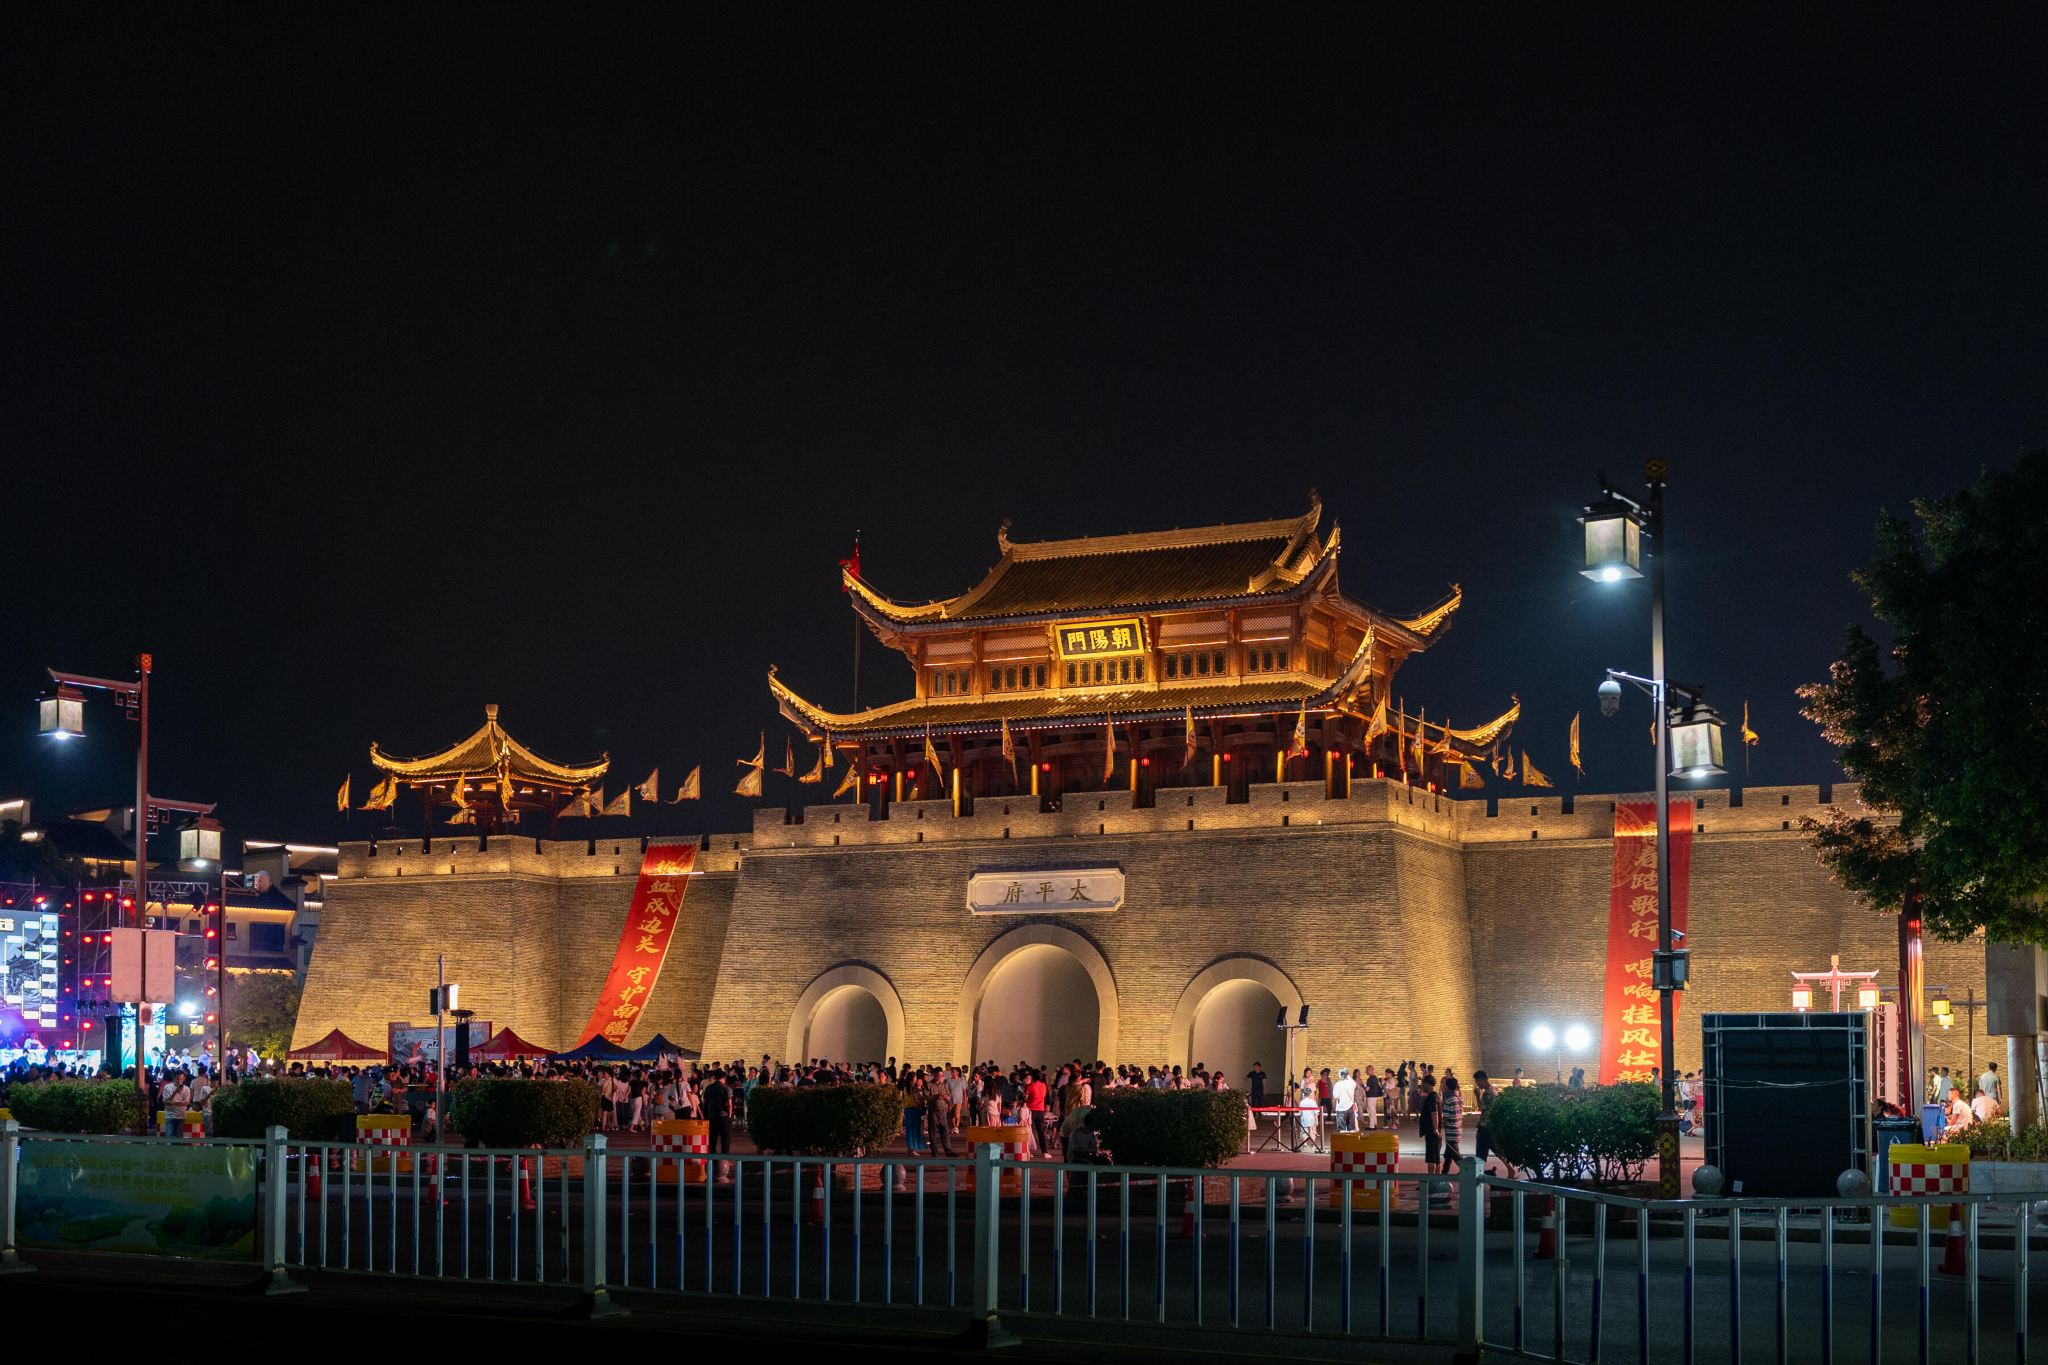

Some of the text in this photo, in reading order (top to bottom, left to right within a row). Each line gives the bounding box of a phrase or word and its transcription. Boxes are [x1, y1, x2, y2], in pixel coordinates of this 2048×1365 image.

[1067, 628, 1132, 651] 朝陽門
[1003, 879, 1092, 903] 太平府
